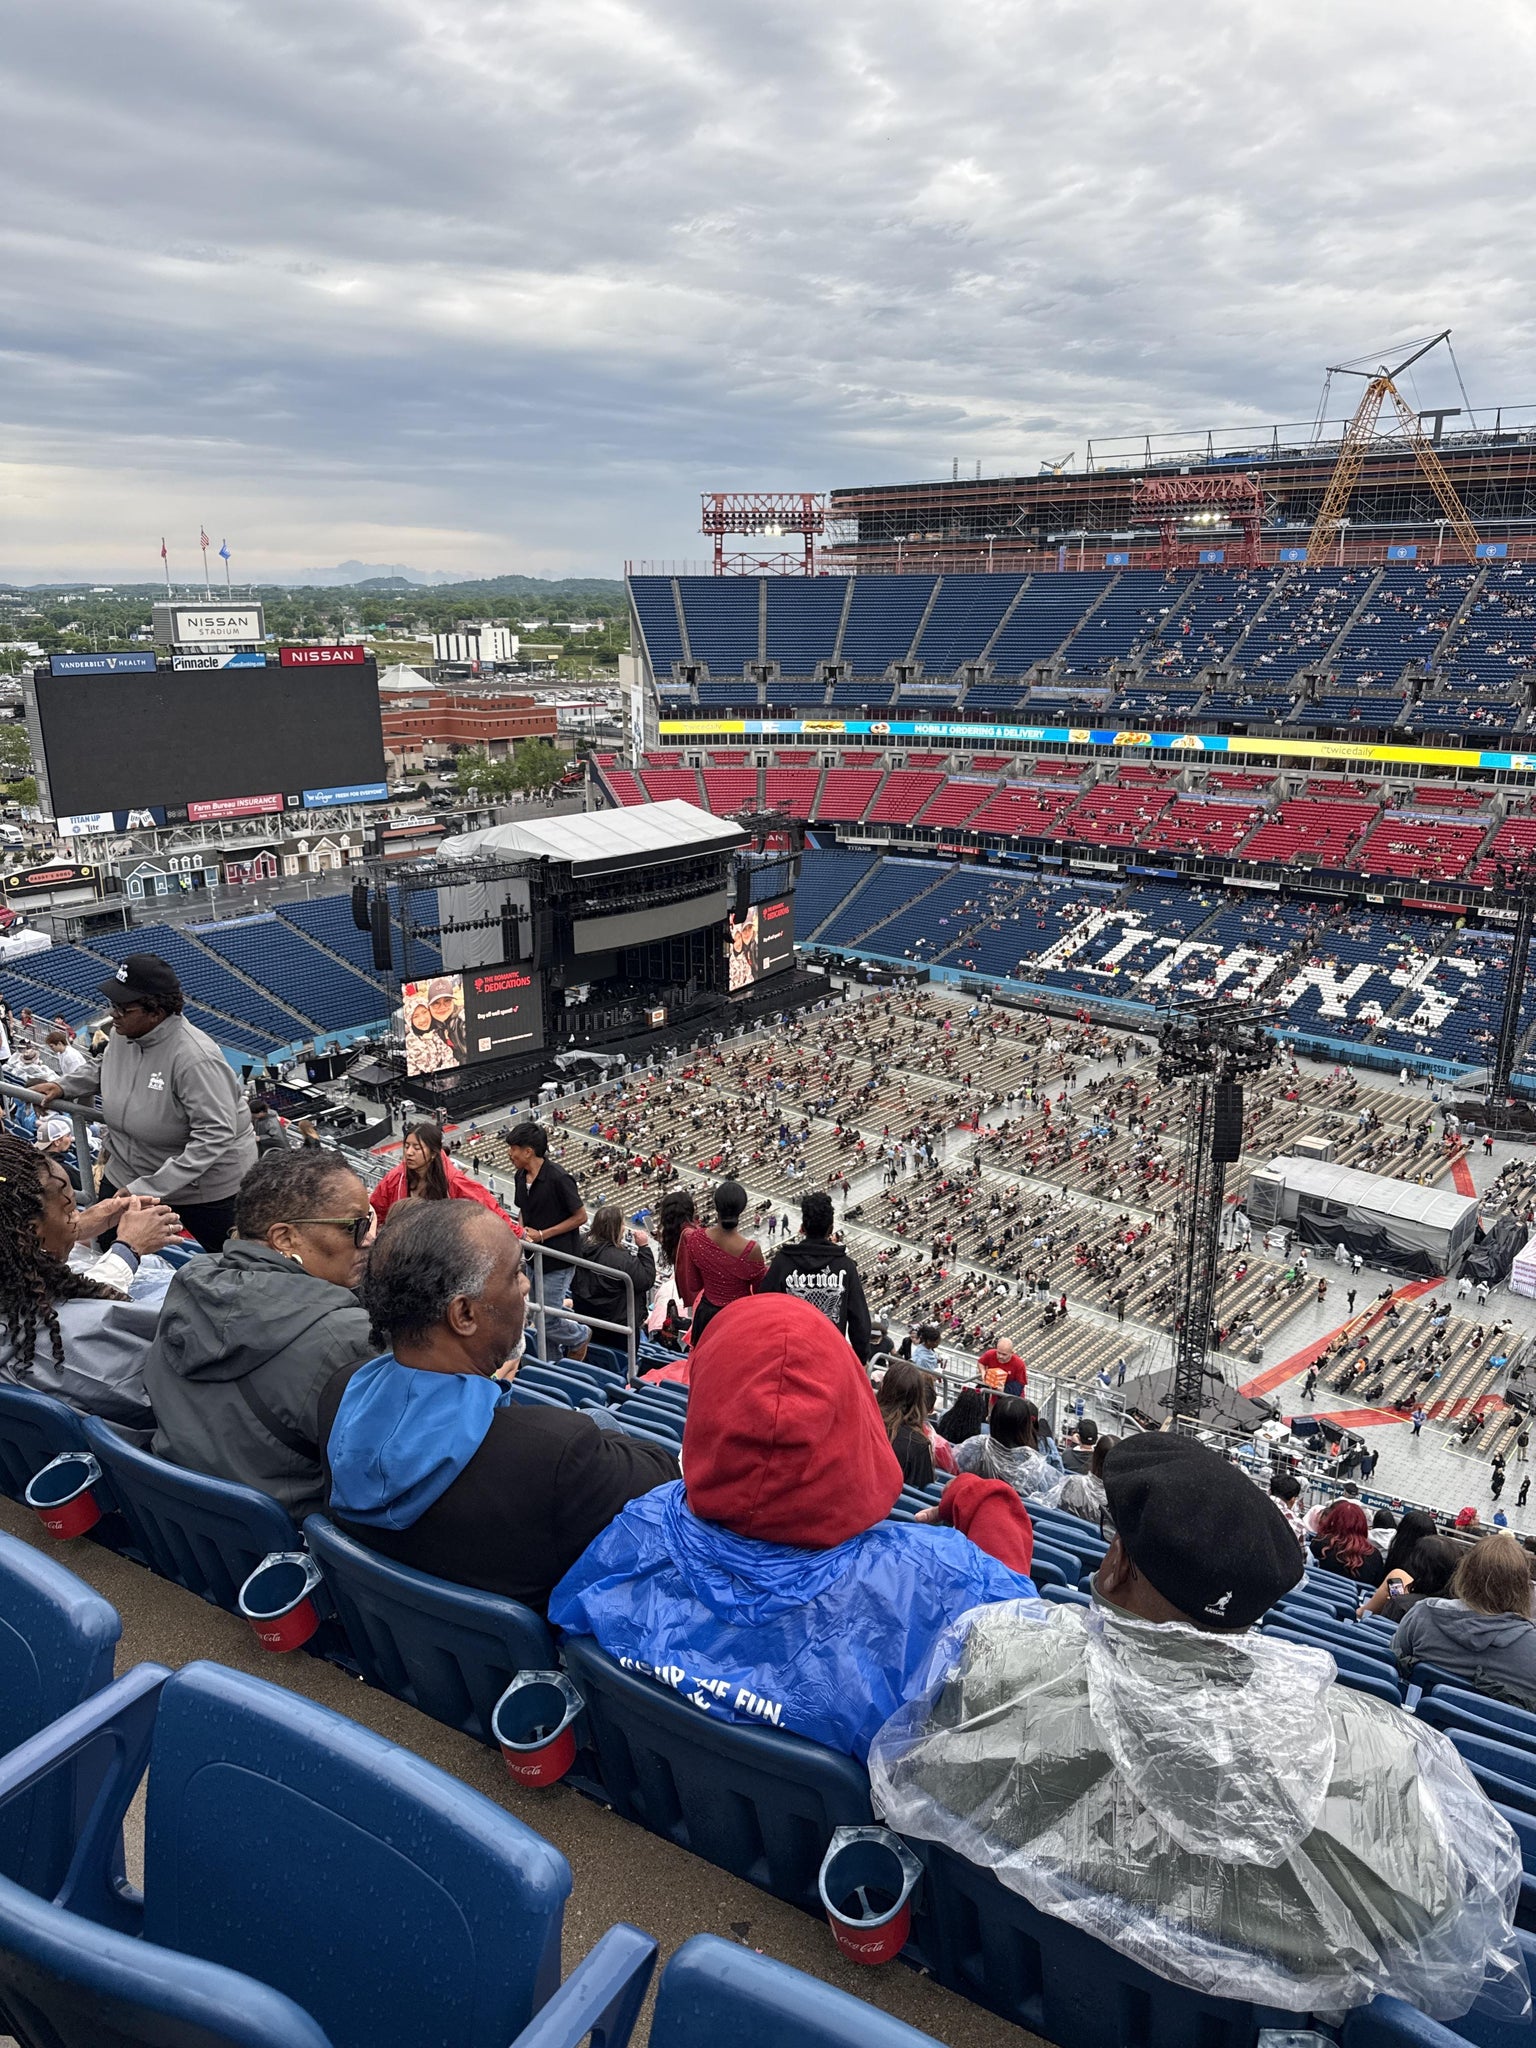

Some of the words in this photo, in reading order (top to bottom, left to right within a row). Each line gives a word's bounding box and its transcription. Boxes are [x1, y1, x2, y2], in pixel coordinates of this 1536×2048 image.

[188, 617, 248, 627] NISSAN
[199, 628, 240, 636] STADIUM
[292, 650, 354, 662] NISSAN
[174, 656, 219, 669] Pinnacle
[914, 724, 948, 734] MOBILE
[949, 725, 995, 736] ORDERING
[995, 728, 1002, 736] &
[1003, 728, 1045, 738] DELIVERY
[212, 801, 236, 810] Bureau
[237, 796, 277, 807] INSURANCE
[70, 815, 91, 824] TITAN
[86, 824, 100, 833] Lite
[494, 971, 519, 980] ROMANTIC
[484, 976, 531, 993] DEDICATIONS
[1416, 1061, 1447, 1075] TENNESSEE
[786, 1269, 847, 1289] eternal
[47, 1520, 63, 1529] Cola
[263, 1632, 281, 1642] Cola
[860, 1939, 885, 1953] Cola
